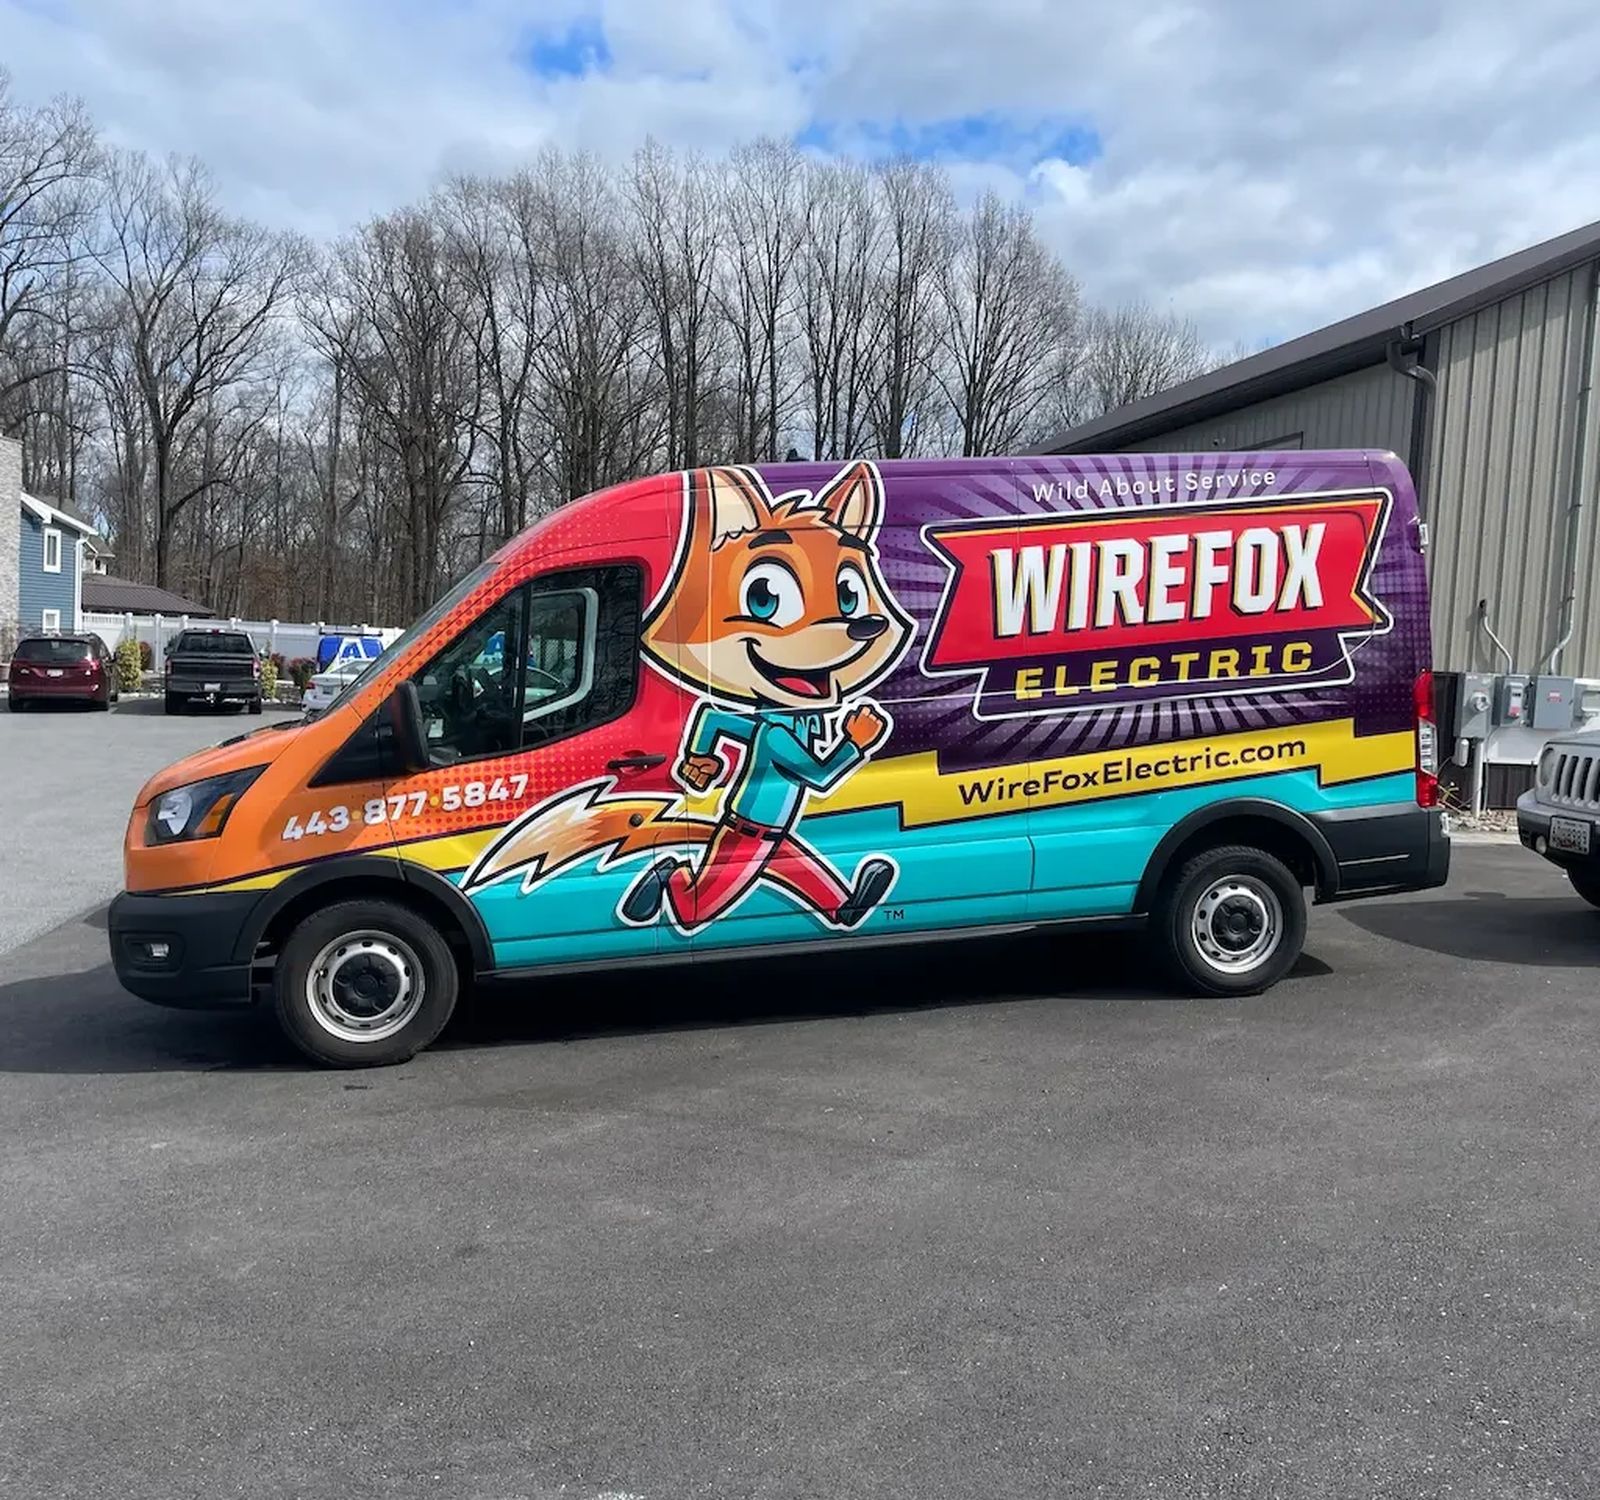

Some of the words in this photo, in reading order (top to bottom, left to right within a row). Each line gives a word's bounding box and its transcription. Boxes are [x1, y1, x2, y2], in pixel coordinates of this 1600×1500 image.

[1032, 479, 1089, 503] Wild
[1099, 475, 1177, 498] About
[1185, 469, 1277, 491] Service
[990, 522, 1326, 637] WIREFOX
[1014, 642, 1313, 700] ELECTRIC
[958, 739, 1306, 806] WireFoxElectric.com
[883, 909, 904, 920] TM
